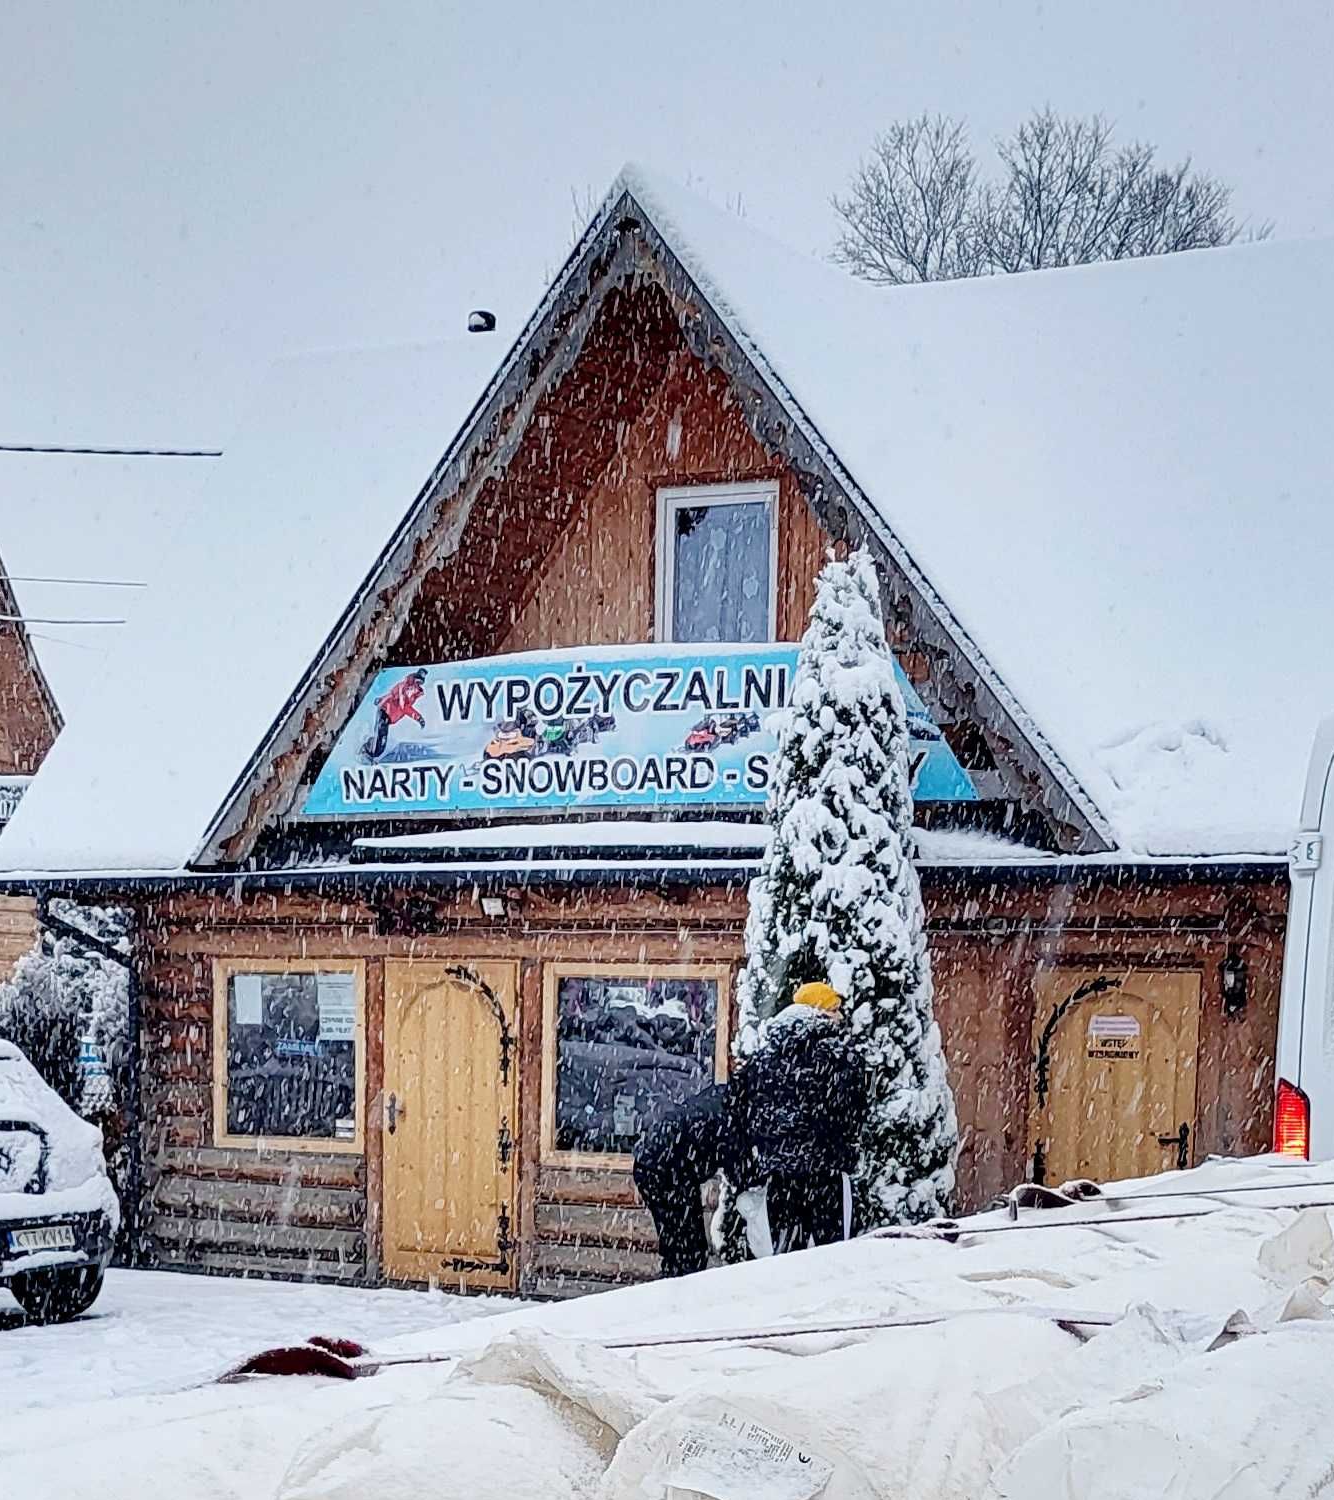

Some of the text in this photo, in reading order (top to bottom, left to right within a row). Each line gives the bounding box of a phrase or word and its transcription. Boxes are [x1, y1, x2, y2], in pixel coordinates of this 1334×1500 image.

[437, 664, 794, 722] WYPOŻYCZALNI
[343, 765, 455, 800] NARTY
[482, 756, 715, 795] SNOWBOARD
